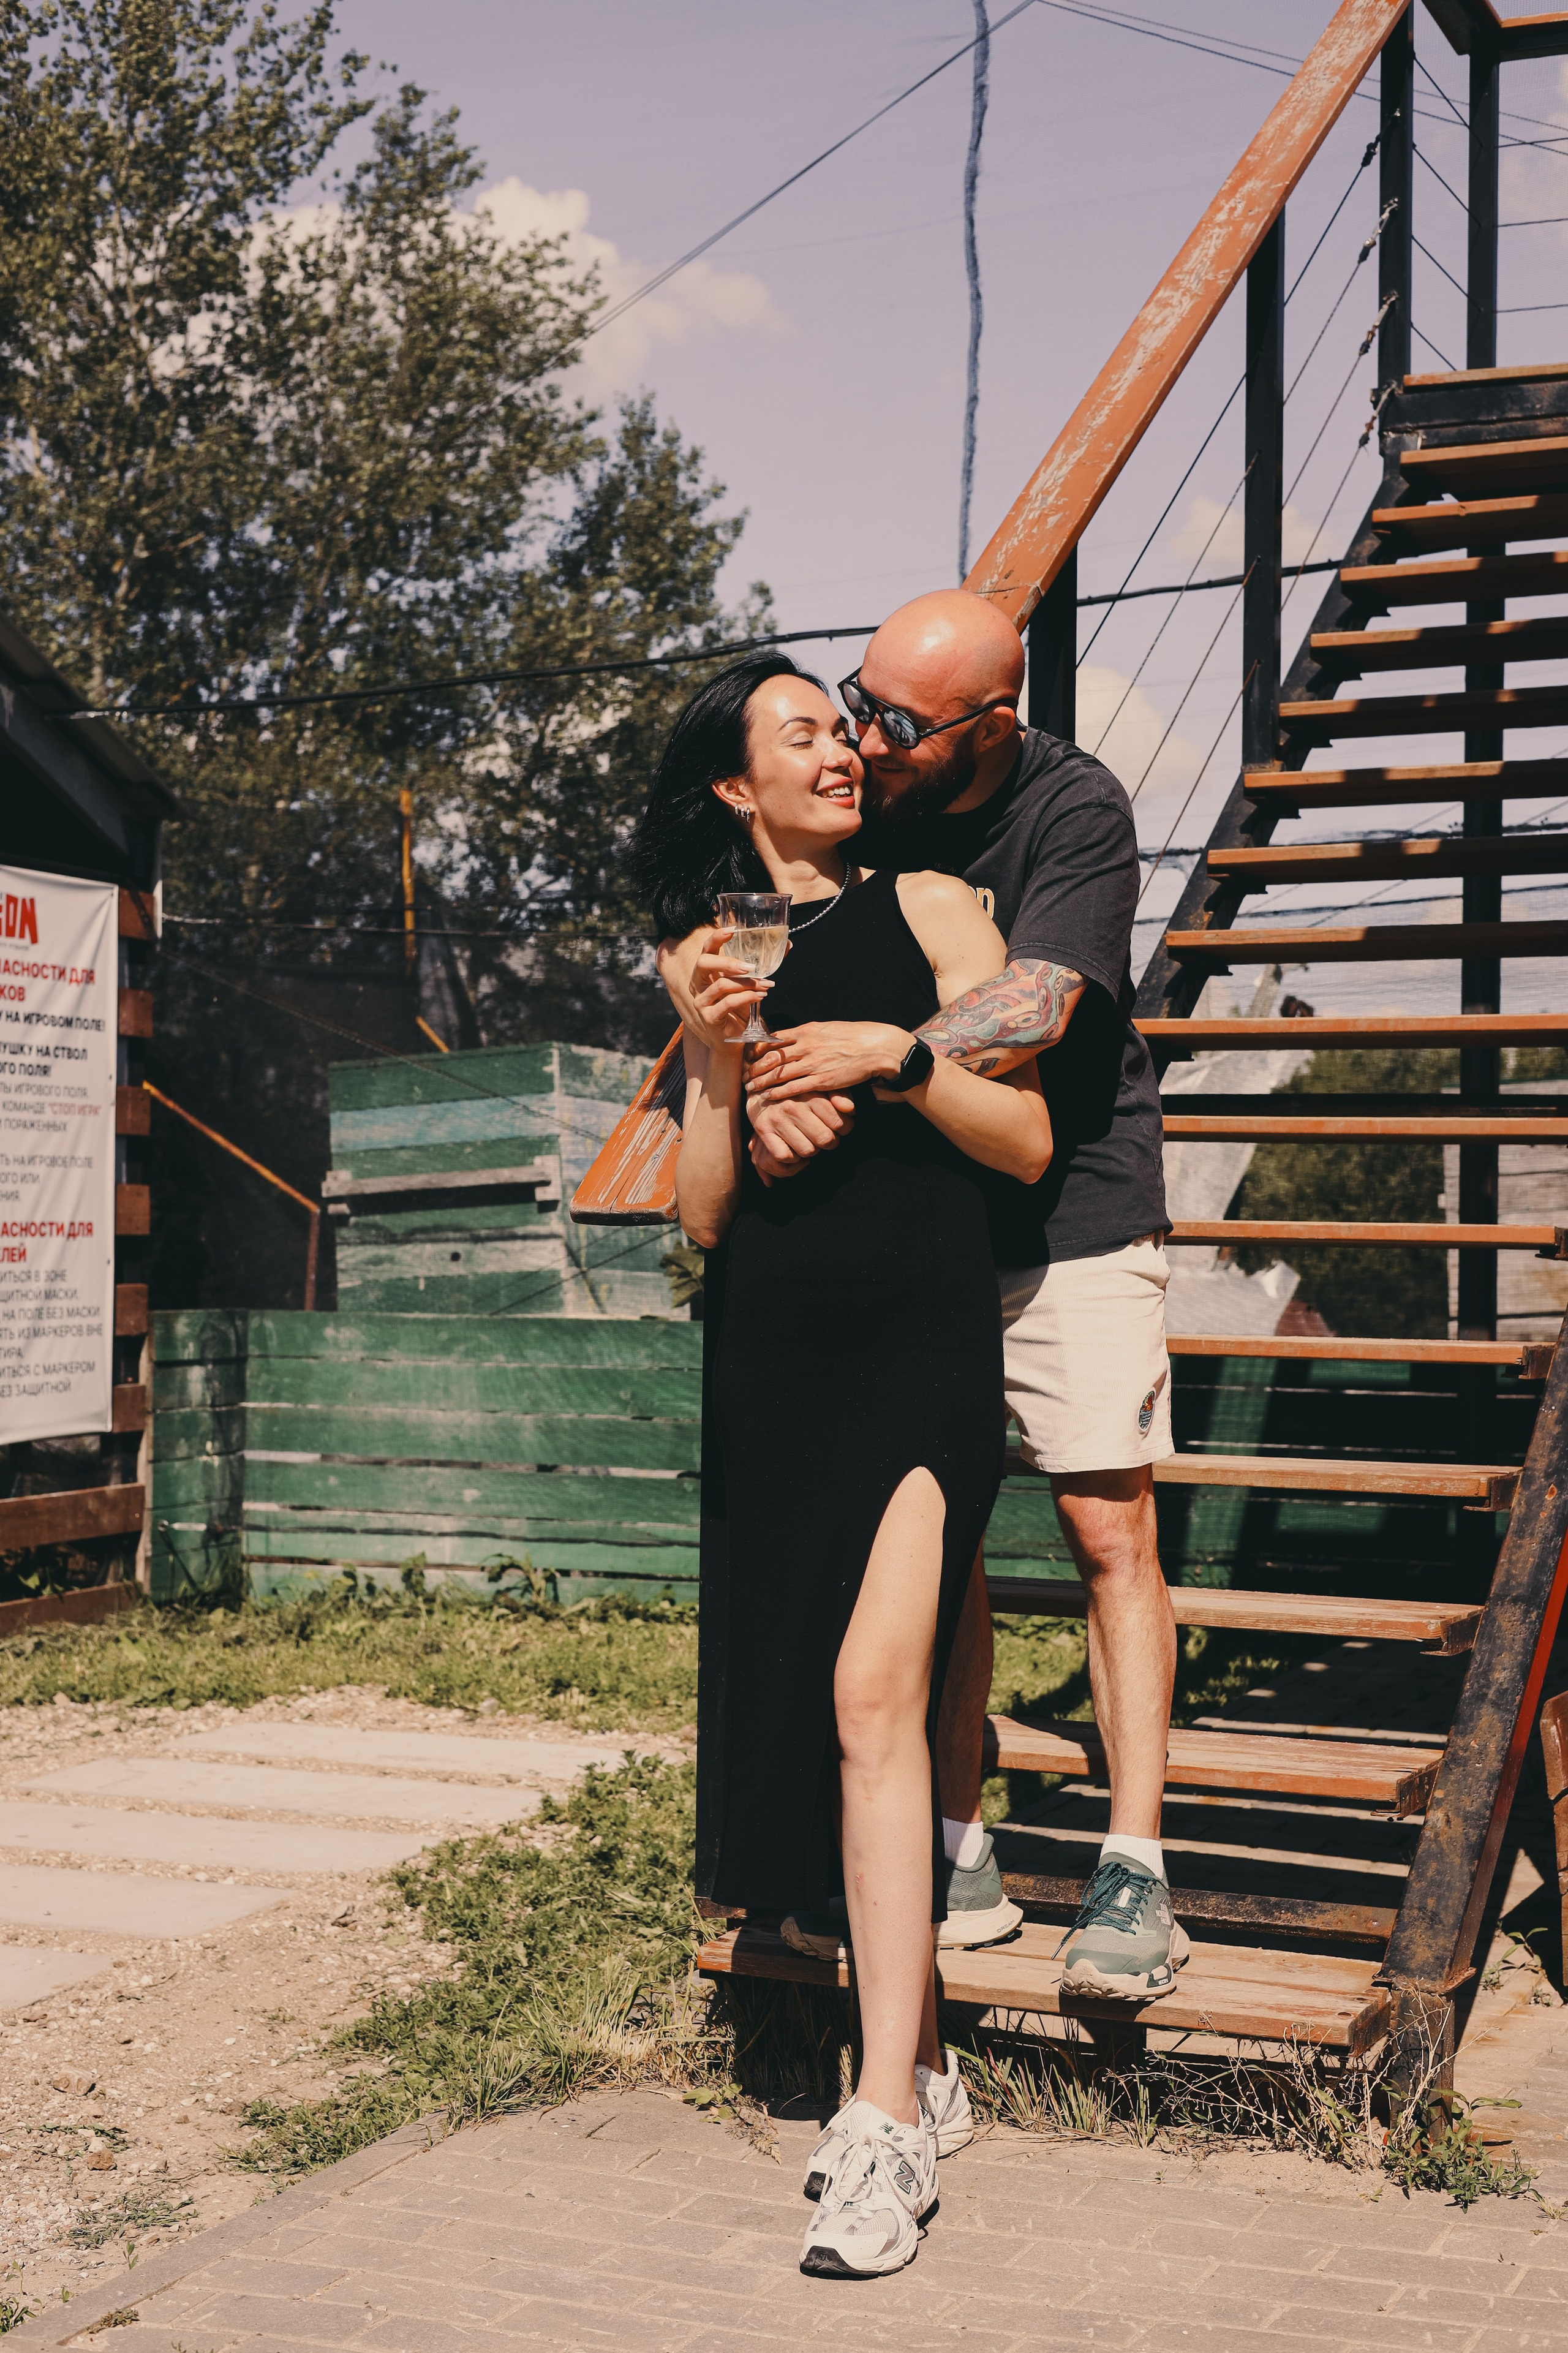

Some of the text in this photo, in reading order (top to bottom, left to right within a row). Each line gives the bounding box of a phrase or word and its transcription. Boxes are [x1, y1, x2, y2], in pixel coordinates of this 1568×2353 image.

[0, 959, 95, 986] АСНОСТИ ДЛЯ
[6, 1011, 20, 1023] НА
[23, 1013, 73, 1029] ИГРОВОМ
[36, 1046, 50, 1057] НА
[53, 1046, 88, 1060] СТВОЛ
[19, 1063, 51, 1077] ПОЛЯ!
[14, 1083, 61, 1097] ИГРОВОГО
[2, 1101, 45, 1115] КОМАНДЕ
[4, 1118, 67, 1132] ПОРАЖЕННЫХ
[13, 1155, 26, 1166] НА
[28, 1155, 67, 1168] ИГРОВОЕ
[69, 1156, 93, 1169] ПОЛЕ
[20, 1173, 40, 1184] ИЛИ
[66, 1222, 93, 1240] ДЛЯ
[44, 1269, 67, 1282] ЗОНЕ
[2, 1306, 100, 1320] НА ПОЛЕ БЕЗ МАСКИ
[18, 1328, 31, 1340] ИЗ
[33, 1324, 84, 1338] МАРКЕРОВ
[86, 1324, 103, 1337] ВНЕ
[16, 1378, 71, 1397] ЗАЩИТНОЙ
[997, 1919, 1016, 1933] DREAM
